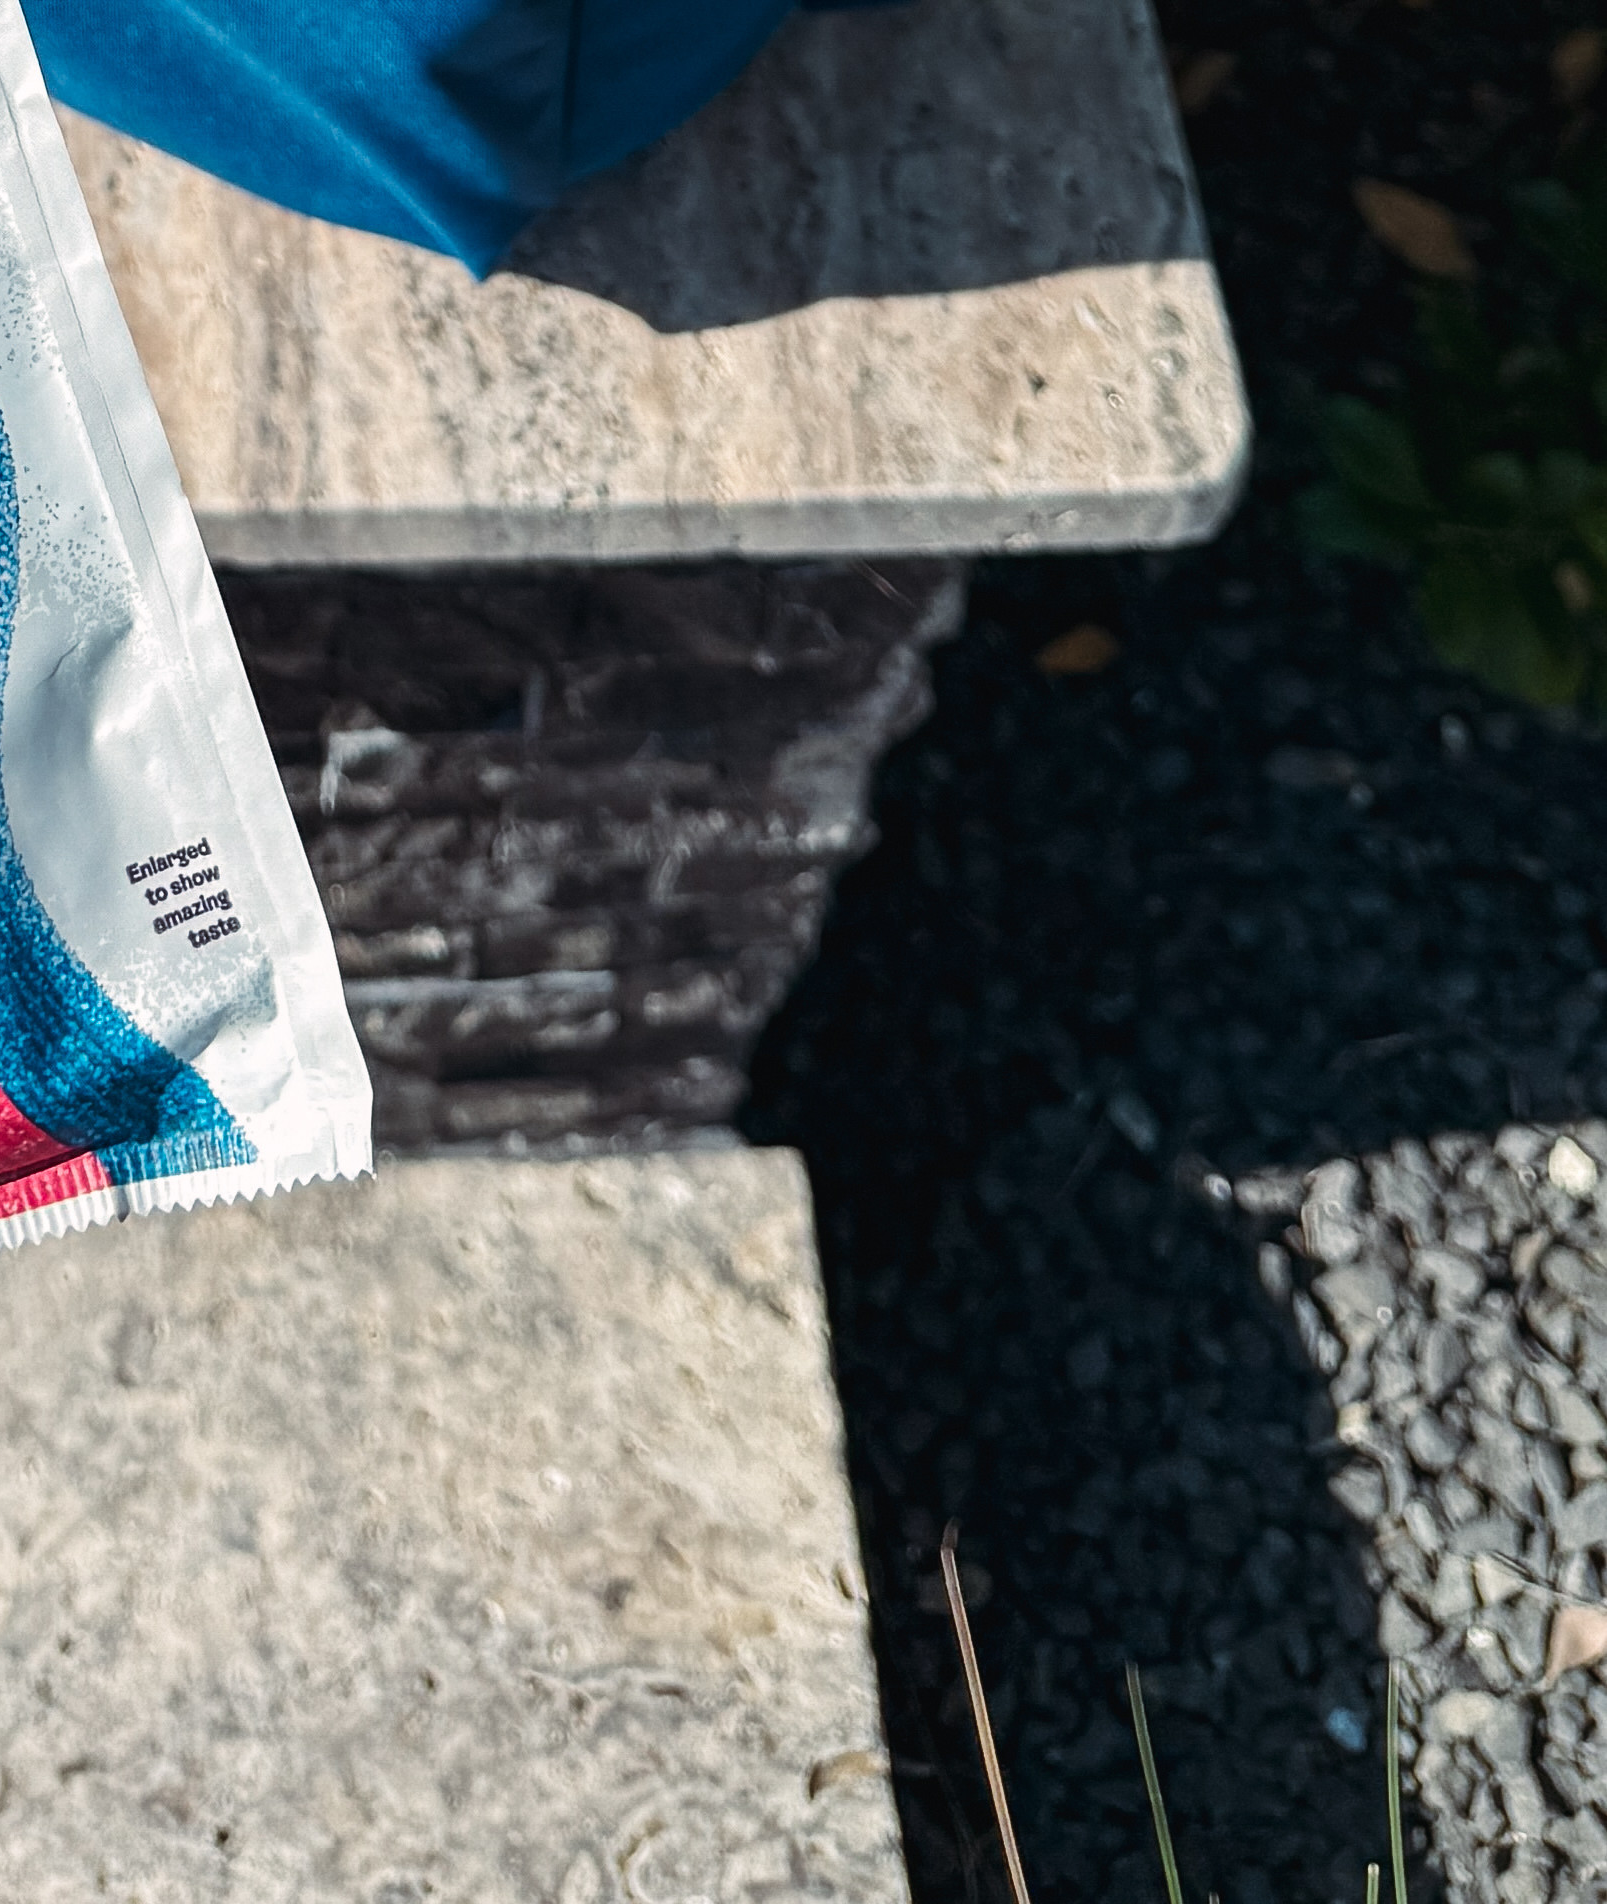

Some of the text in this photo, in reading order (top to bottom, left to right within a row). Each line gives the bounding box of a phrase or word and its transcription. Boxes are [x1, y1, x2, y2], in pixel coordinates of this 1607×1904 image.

[126, 837, 212, 884] Enlarged
[144, 865, 220, 907] to show
[152, 888, 233, 935] amazing
[187, 916, 241, 949] taste
